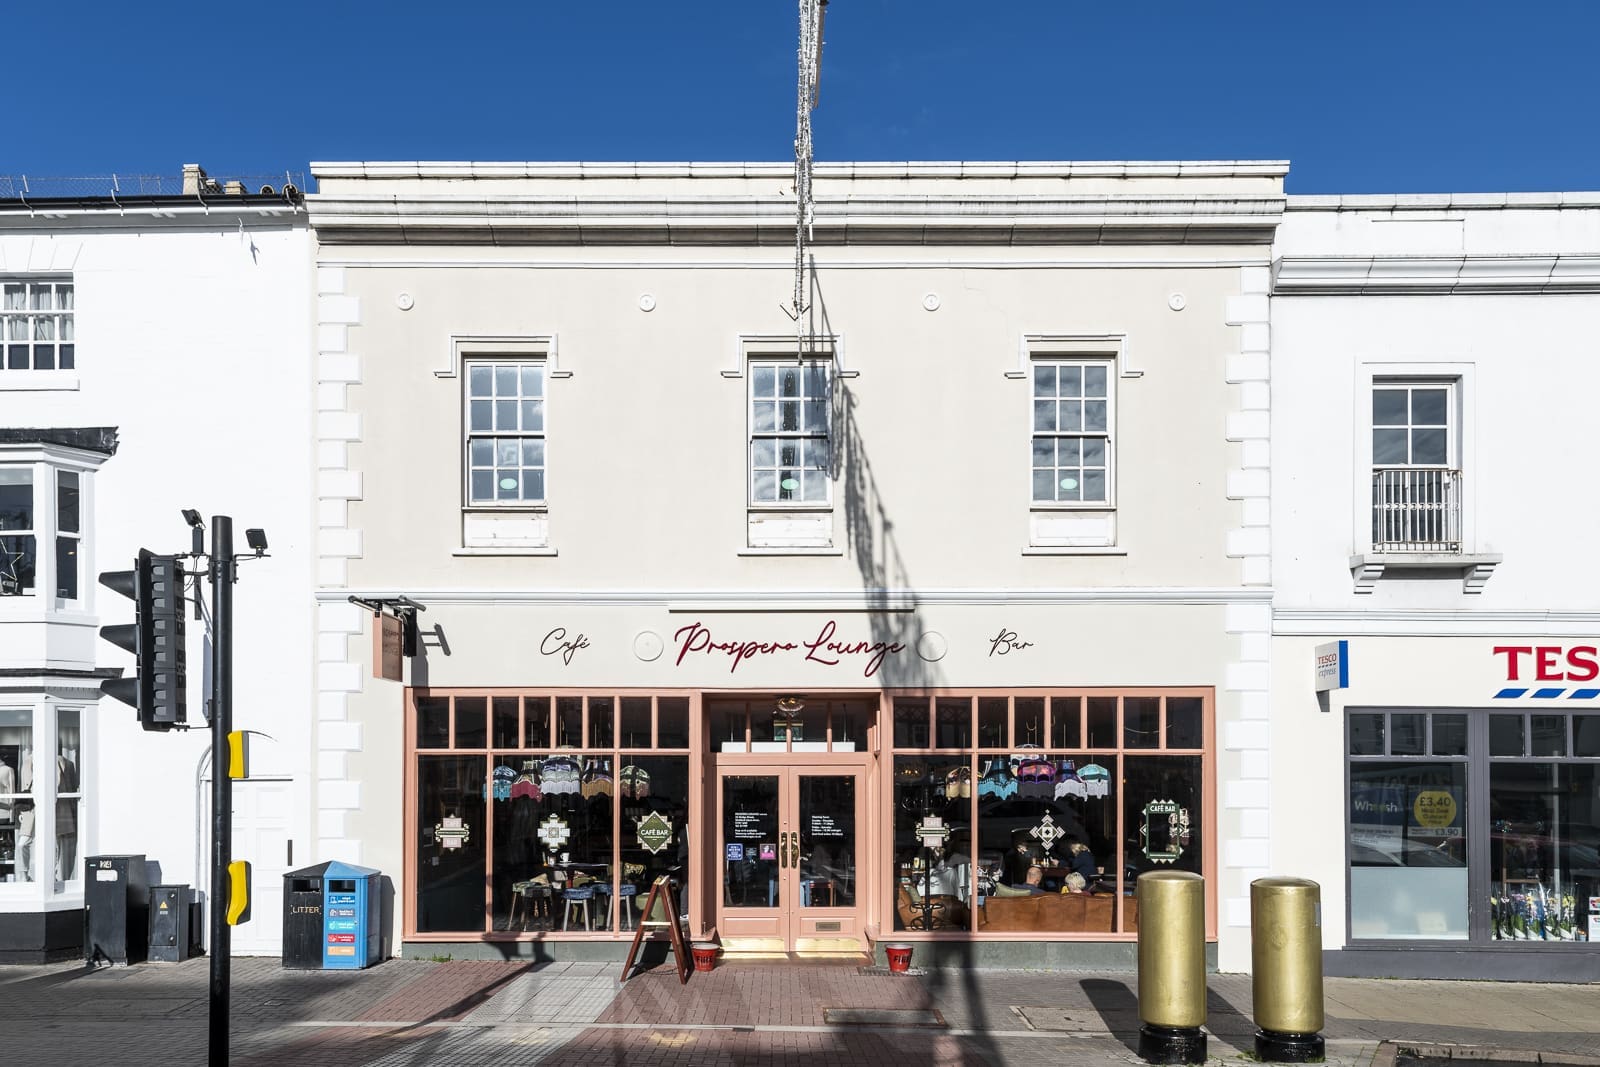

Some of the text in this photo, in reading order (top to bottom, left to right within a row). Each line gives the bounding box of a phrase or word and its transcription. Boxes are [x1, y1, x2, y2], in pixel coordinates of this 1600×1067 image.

[540, 627, 591, 666] Café
[674, 620, 906, 678] Prospero Lounge
[989, 628, 1034, 657] Bar
[1317, 653, 1337, 664] TESCO
[1493, 646, 1599, 681] TES
[1420, 797, 1451, 807] £3.40
[292, 906, 320, 914] LITTER
